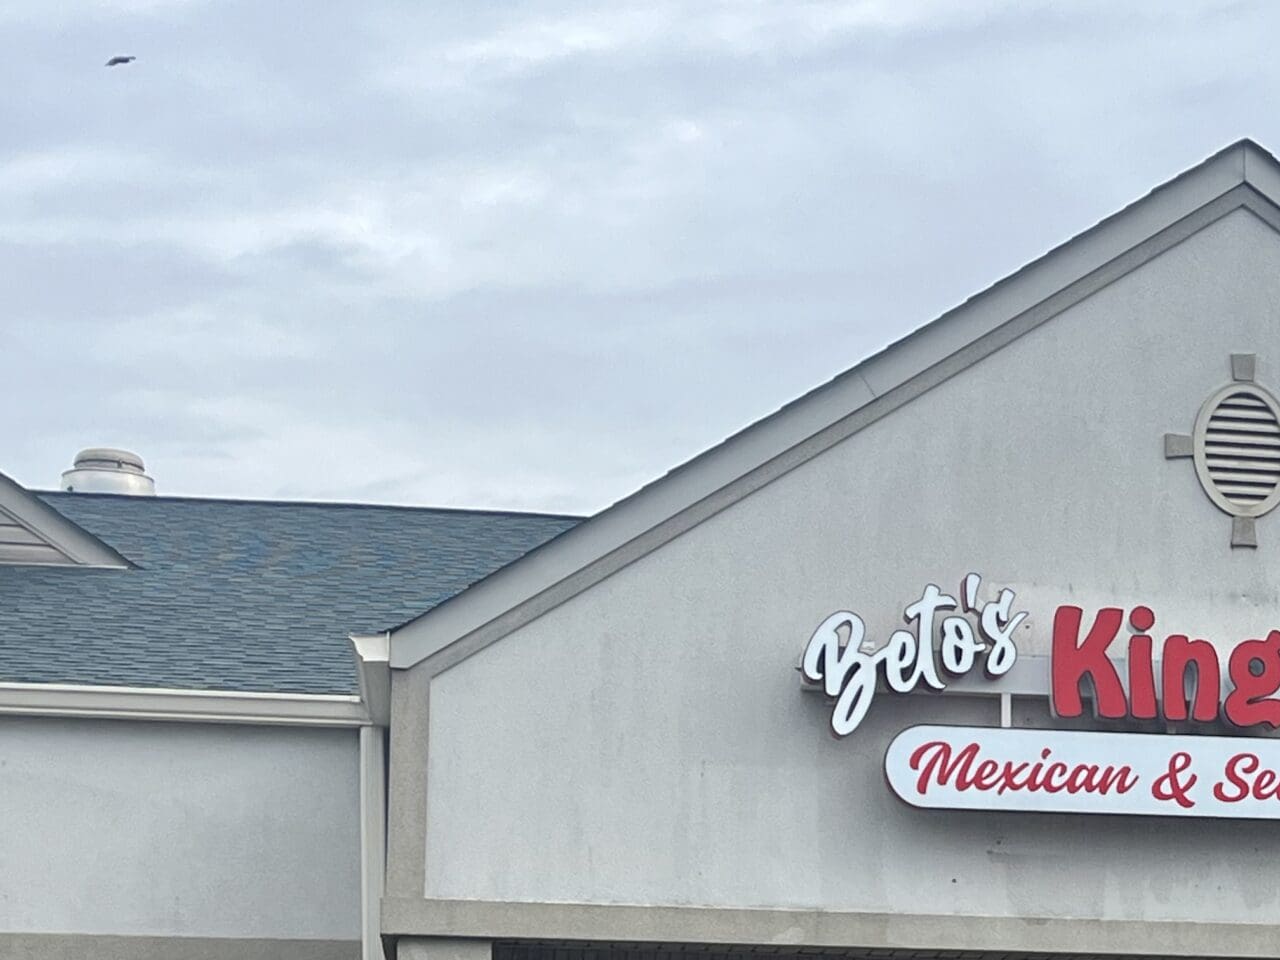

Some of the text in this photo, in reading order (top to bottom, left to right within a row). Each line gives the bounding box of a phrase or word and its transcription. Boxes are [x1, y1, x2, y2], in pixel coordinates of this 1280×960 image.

[803, 573, 1028, 737] Beto's
[909, 741, 1139, 795] Mexican
[1151, 752, 1197, 808] &
